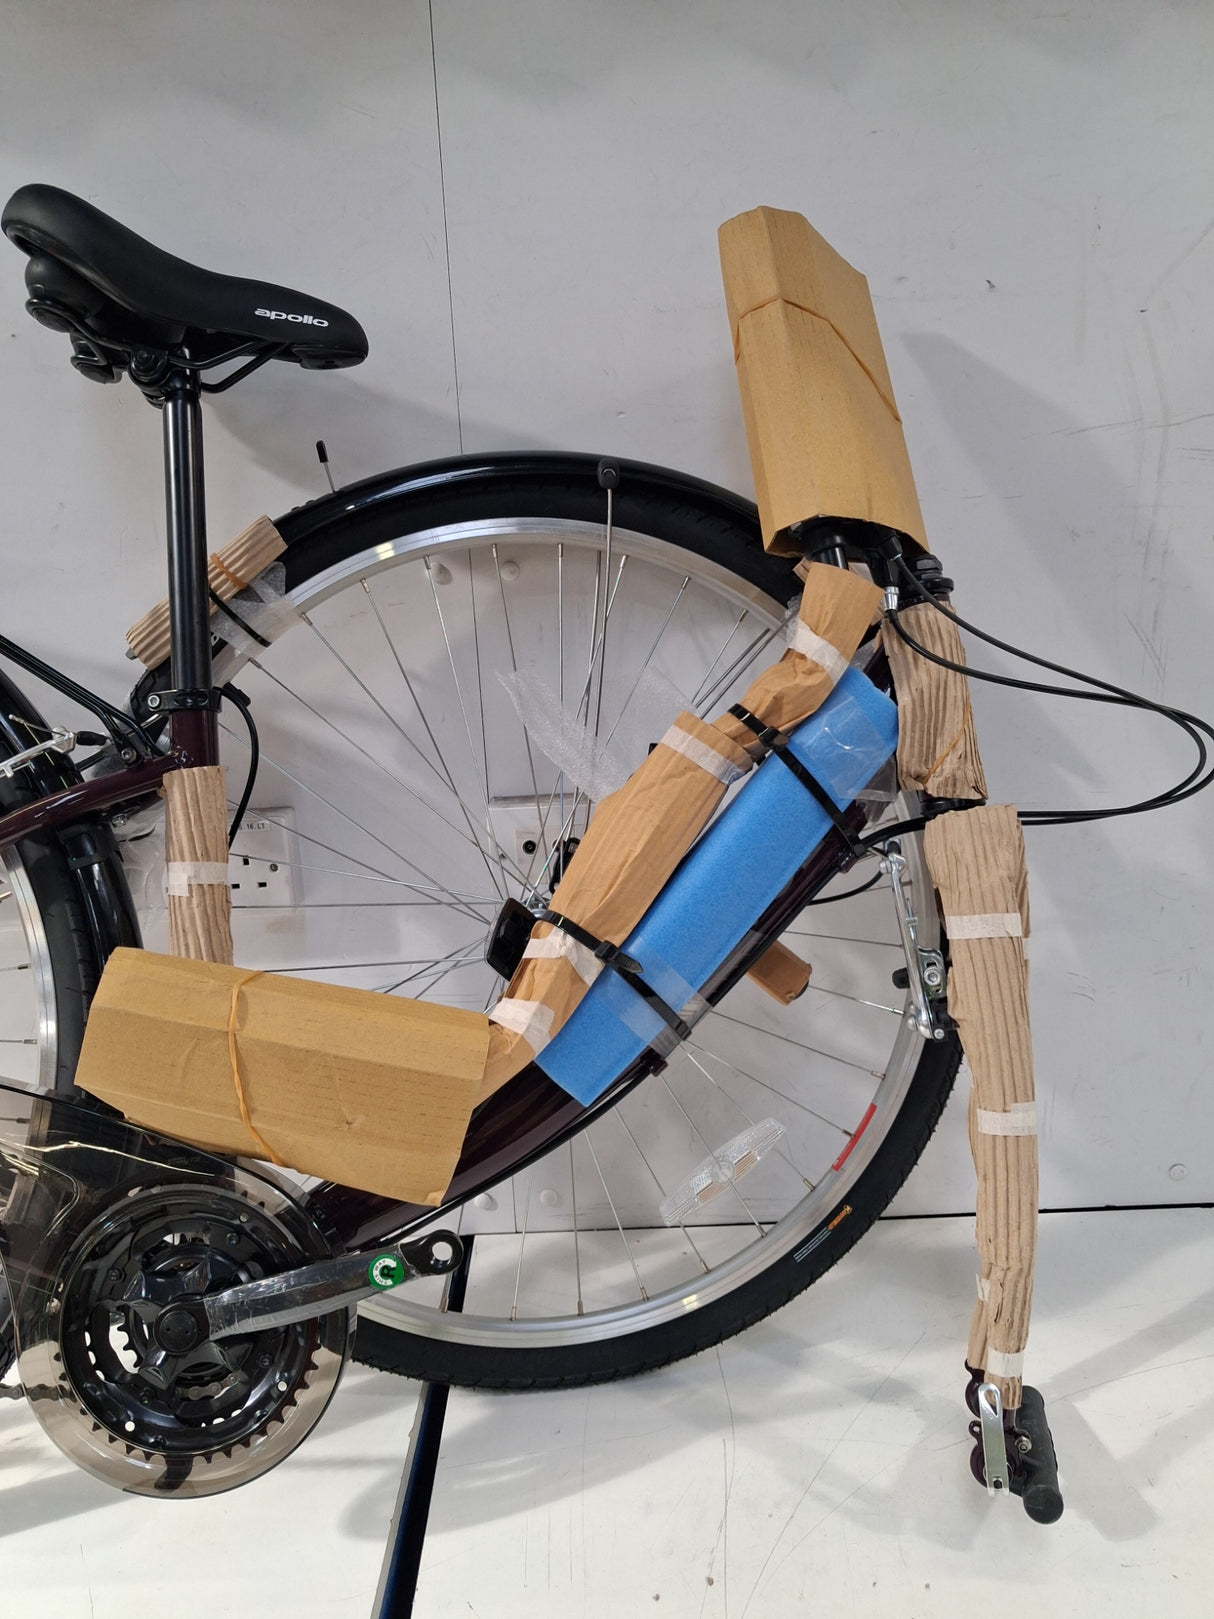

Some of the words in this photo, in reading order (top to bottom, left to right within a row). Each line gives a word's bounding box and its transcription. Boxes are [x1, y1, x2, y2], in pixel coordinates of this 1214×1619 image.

[254, 308, 329, 327] apollo
[374, 1259, 386, 1271] WAY
[380, 1264, 396, 1279] R
[374, 1273, 388, 1285] THIS
